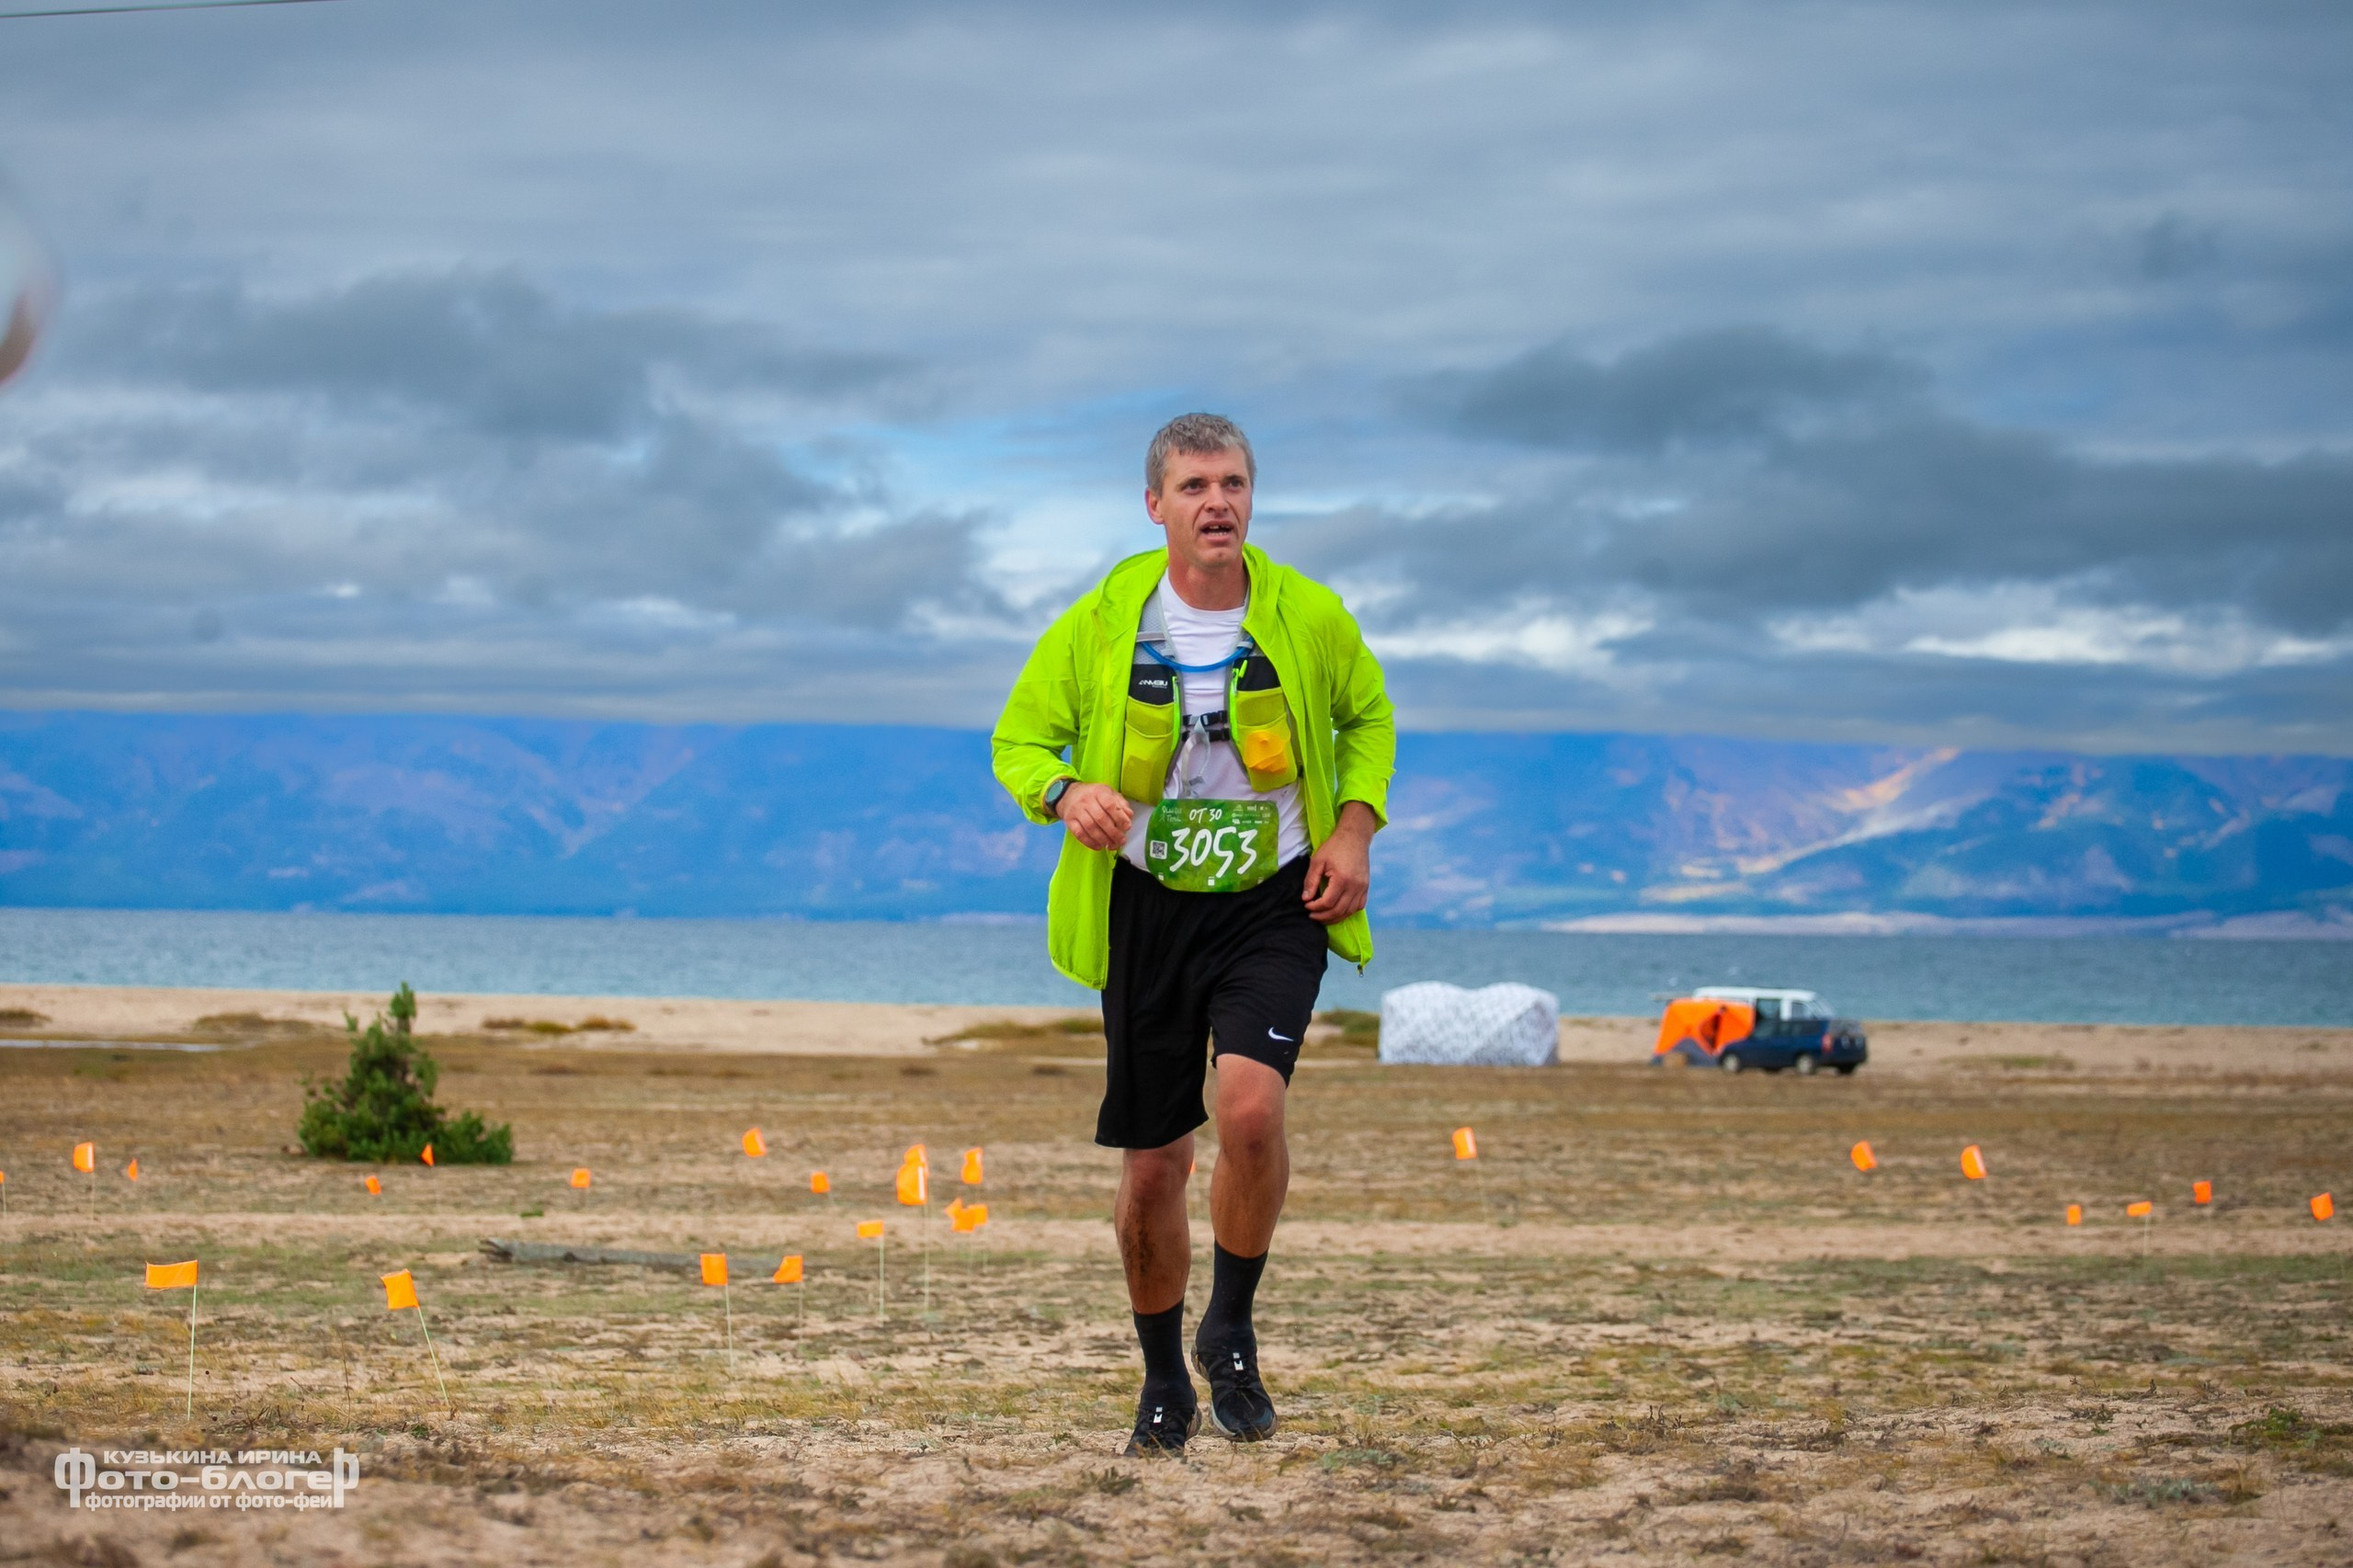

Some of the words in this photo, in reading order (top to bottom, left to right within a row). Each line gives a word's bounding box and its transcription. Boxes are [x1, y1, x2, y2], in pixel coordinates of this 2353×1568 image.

[1188, 807, 1208, 824] OT
[1209, 808, 1222, 823] 30
[1169, 826, 1258, 878] 3053
